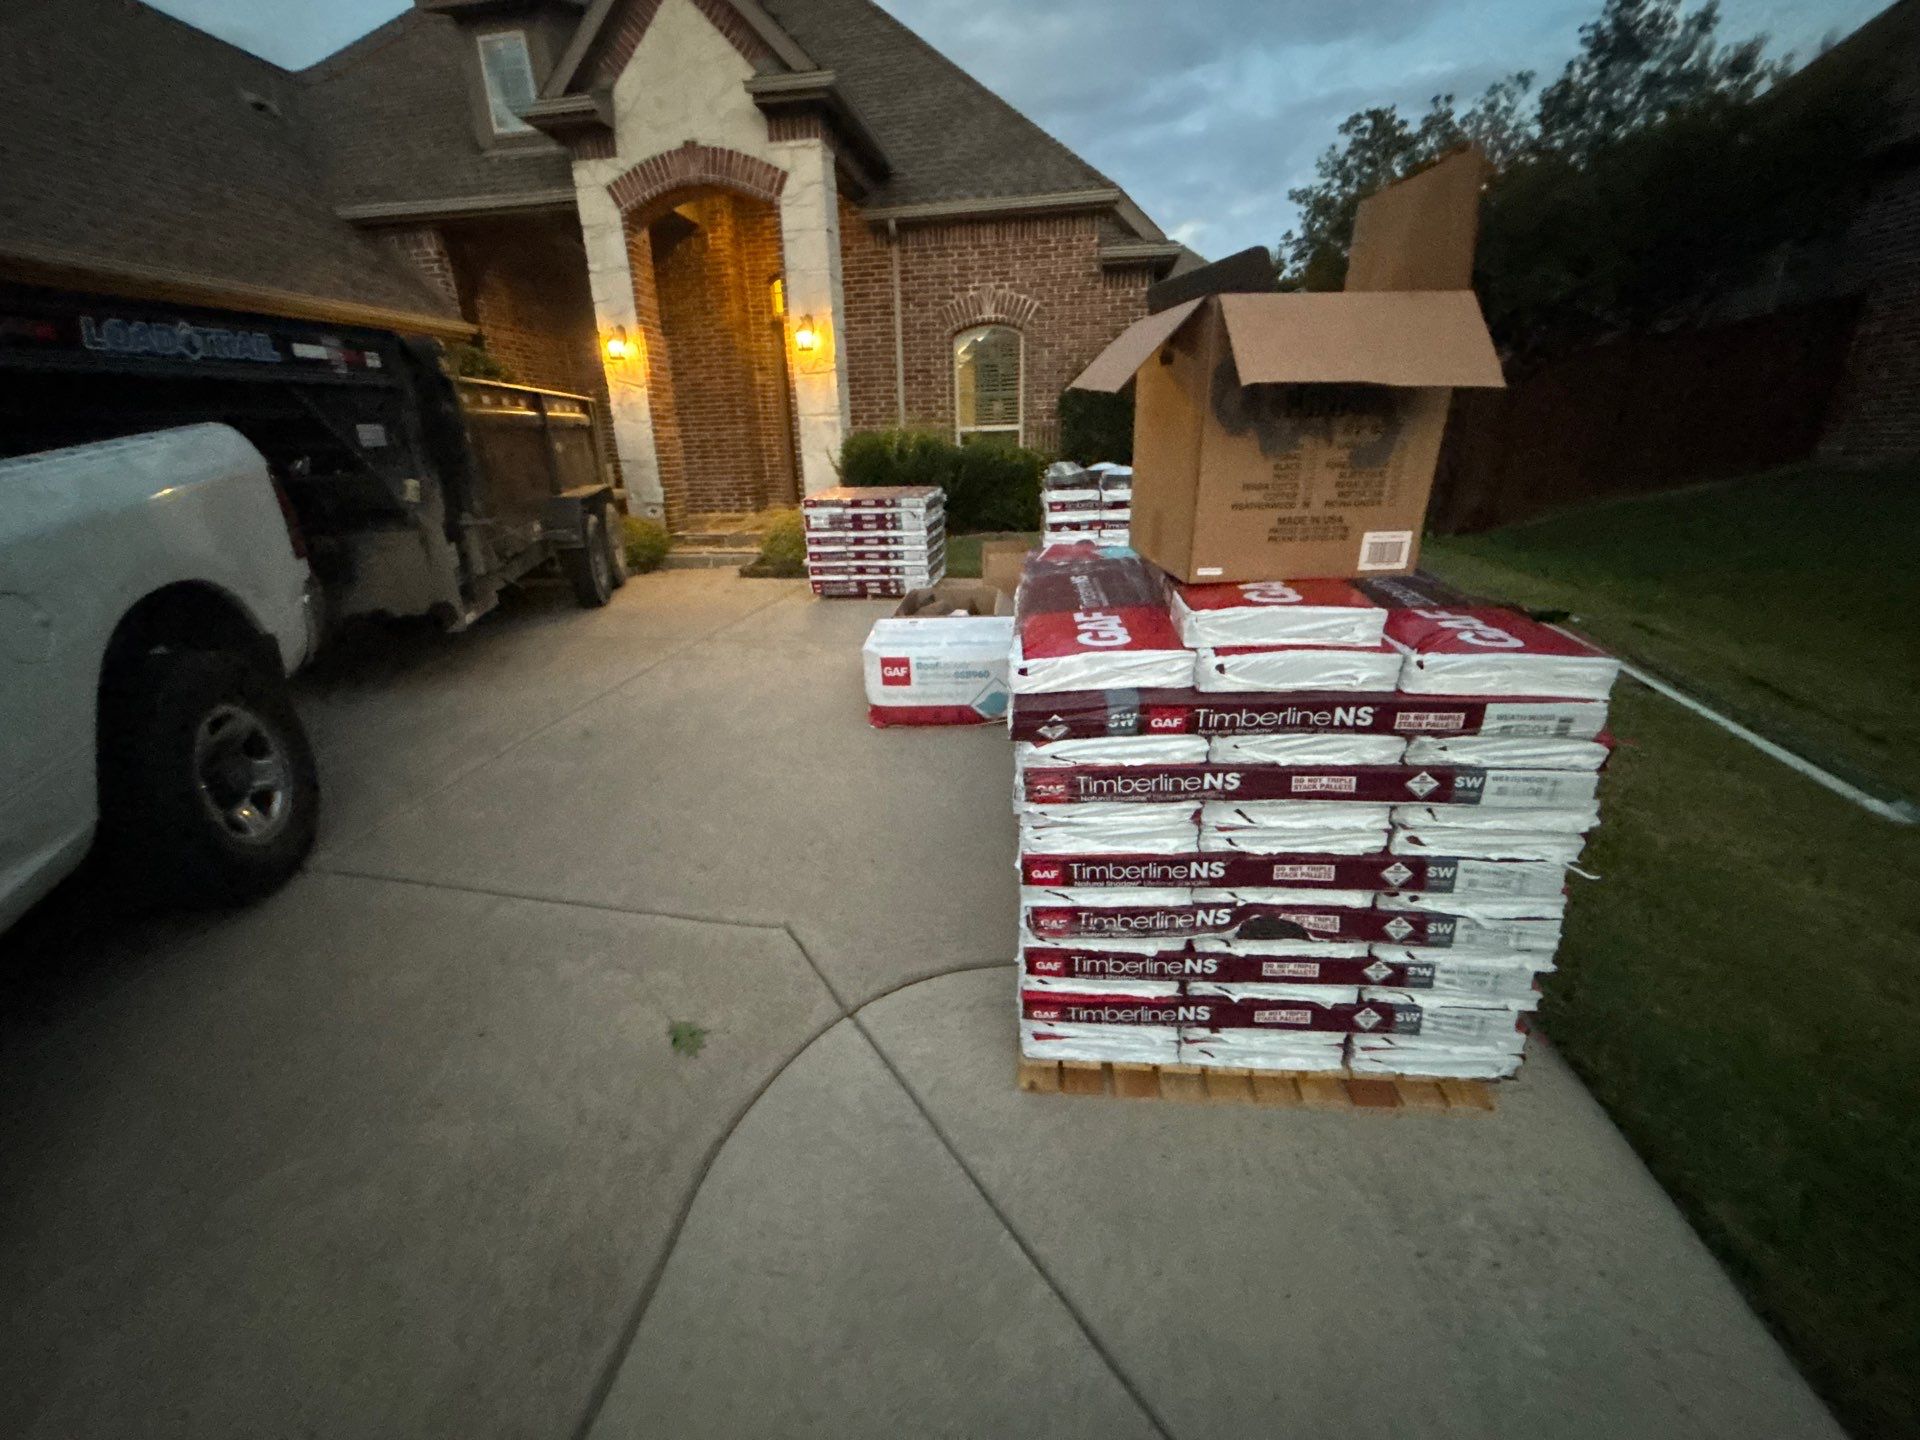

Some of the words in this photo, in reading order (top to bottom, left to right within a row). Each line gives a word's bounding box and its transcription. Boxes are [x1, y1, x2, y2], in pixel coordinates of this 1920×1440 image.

[1073, 612, 1131, 647] GAF
[883, 667, 908, 677] GAF
[1151, 718, 1184, 728] GAF
[1455, 776, 1484, 789] SW
[1031, 869, 1059, 879] GAF
[1427, 866, 1456, 878] SW
[1427, 922, 1454, 934] SW
[1035, 962, 1062, 970] GAF
[1407, 966, 1432, 976] SW
[1033, 1010, 1059, 1019] GAF
[1395, 1012, 1419, 1023] SW
